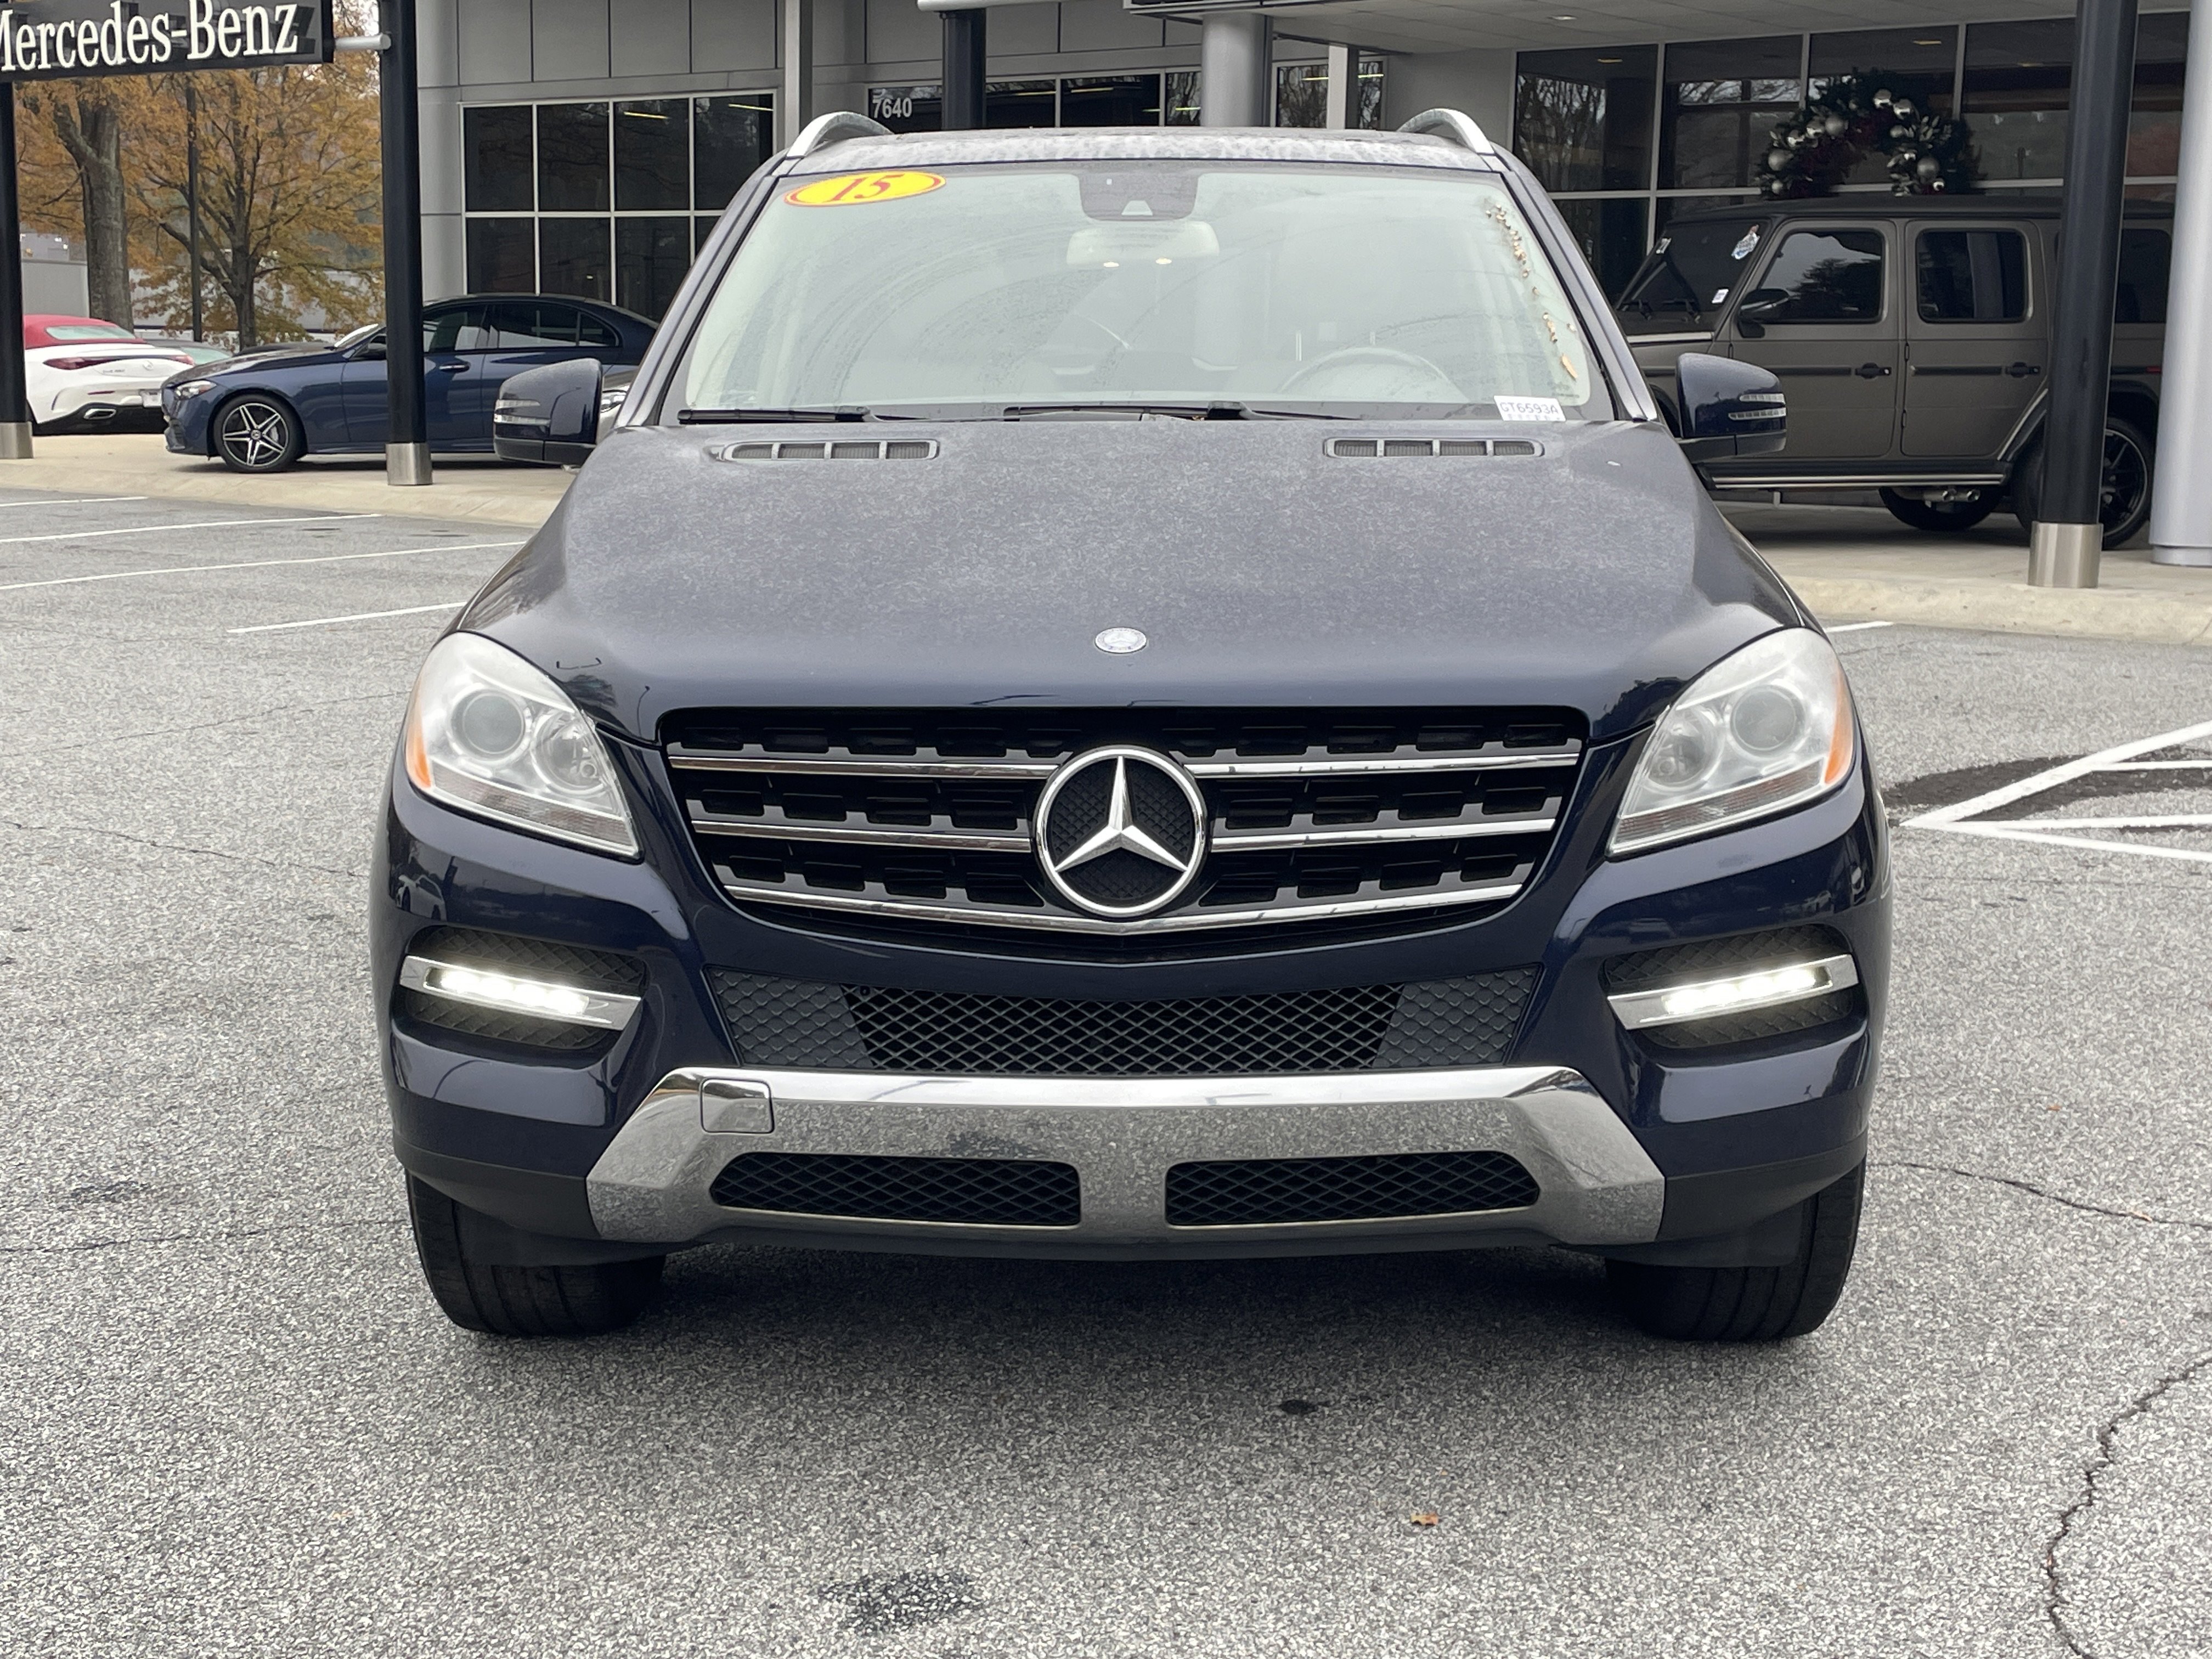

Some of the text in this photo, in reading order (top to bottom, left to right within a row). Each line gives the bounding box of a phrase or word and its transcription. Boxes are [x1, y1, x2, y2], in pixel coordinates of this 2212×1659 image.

[872, 97, 912, 119] 7640
[823, 173, 905, 202] 15
[1499, 402, 1559, 414] GT6593A
